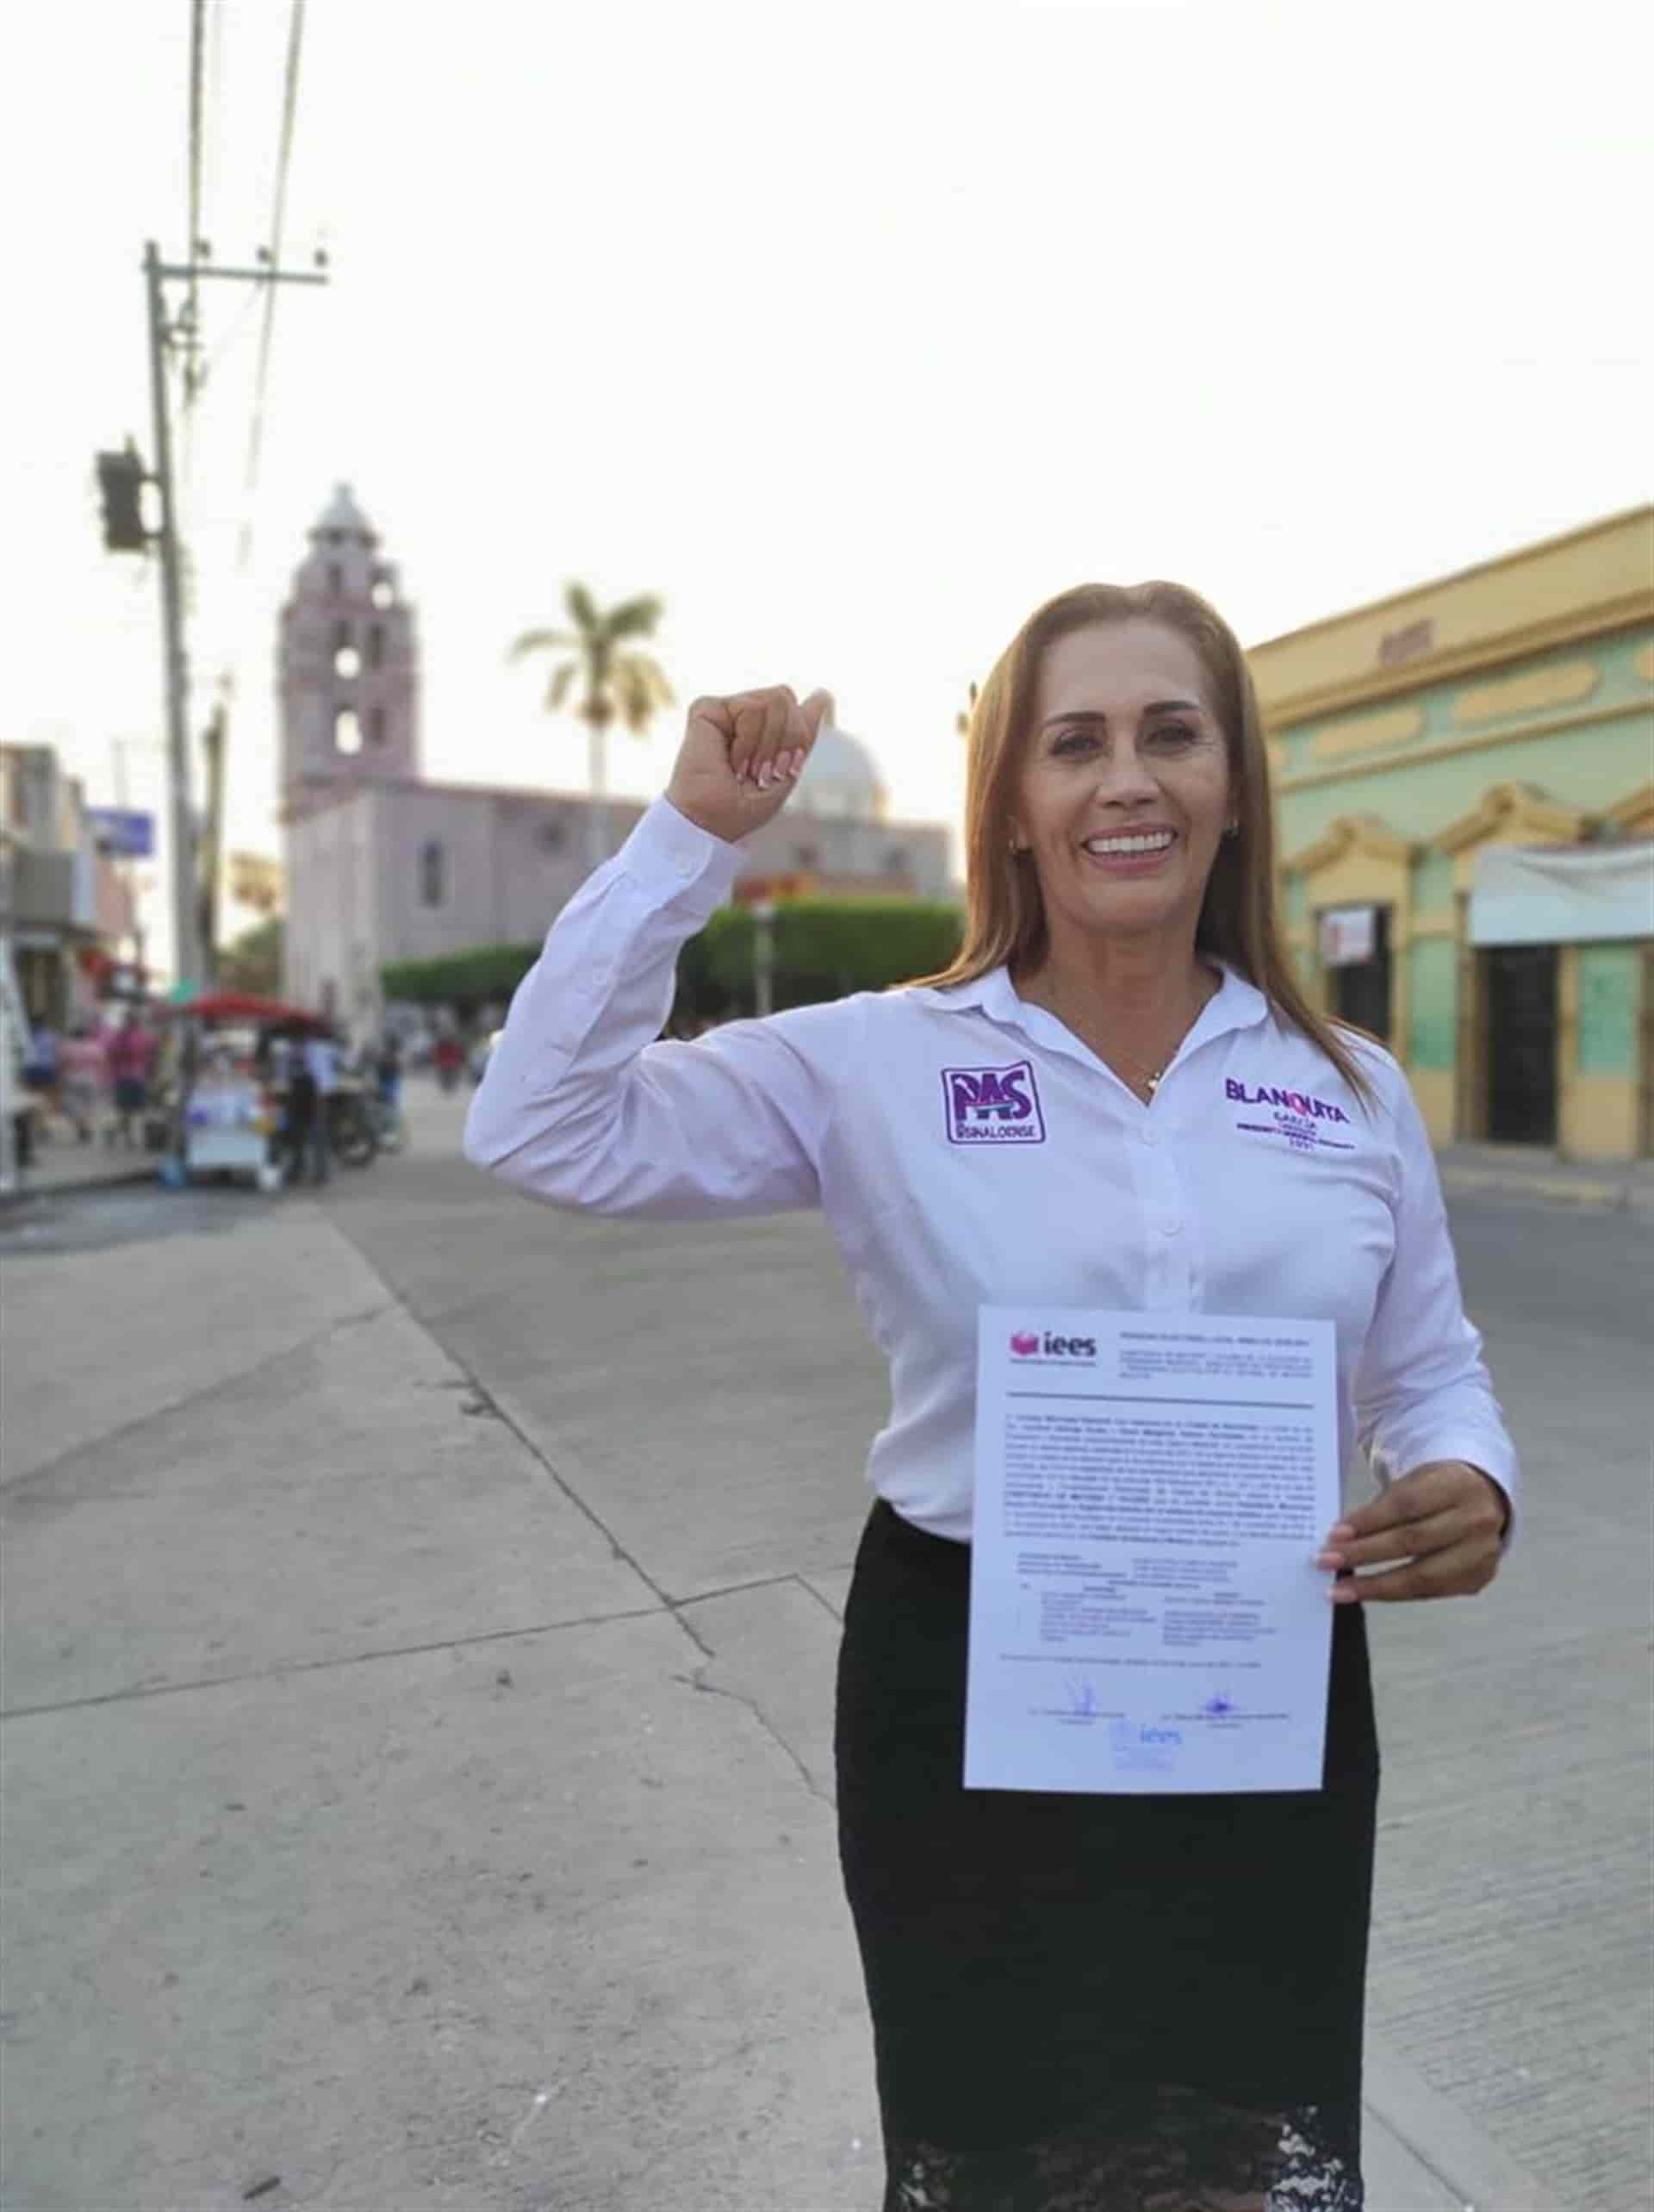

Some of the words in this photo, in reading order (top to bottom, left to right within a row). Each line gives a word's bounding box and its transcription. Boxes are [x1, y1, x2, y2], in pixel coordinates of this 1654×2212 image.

[950, 1069, 1032, 1120] PAS
[1226, 1078, 1350, 1124] BLANQUITA
[1043, 1331, 1097, 1356] iees
